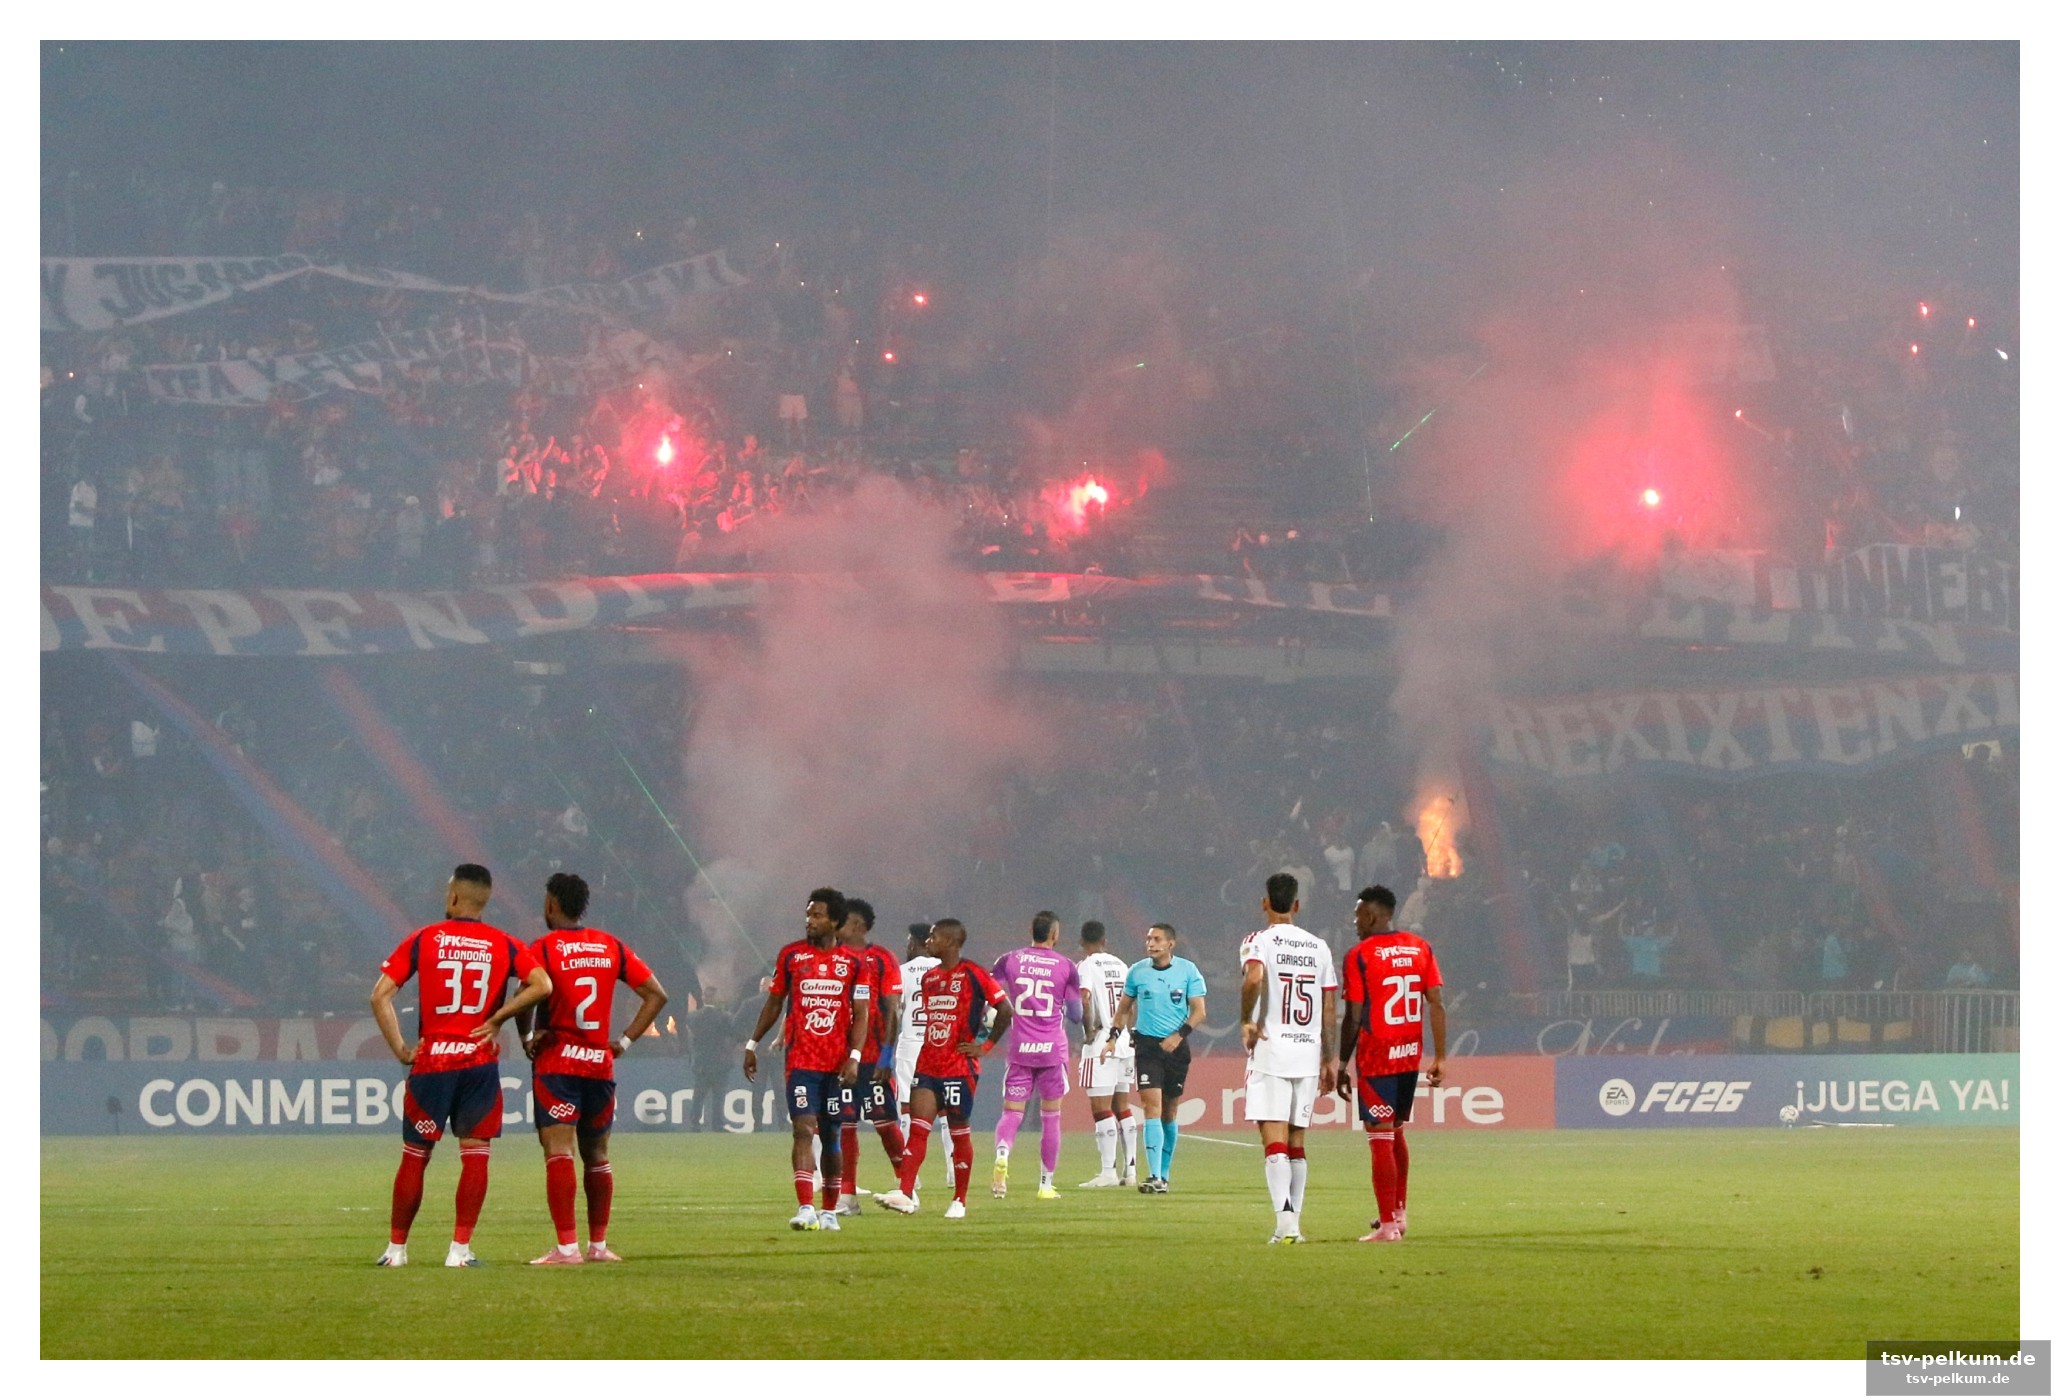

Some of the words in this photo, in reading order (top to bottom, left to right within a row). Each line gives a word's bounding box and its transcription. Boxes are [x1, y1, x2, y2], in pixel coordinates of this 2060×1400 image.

[1284, 938, 1318, 949] Hapvida
[438, 949, 447, 959] D.
[448, 949, 492, 962] LONDOÑO
[436, 960, 492, 1014] 33
[801, 981, 842, 993] Colanta
[574, 976, 600, 1030] 2
[1015, 977, 1055, 1017] 25
[1278, 972, 1316, 1026] 15
[1382, 974, 1421, 1025] 26
[804, 1010, 837, 1030] Pool
[430, 1042, 478, 1055] MAPE
[561, 1044, 606, 1063] MAPEI
[1019, 1042, 1054, 1053] MAPEI
[1389, 1042, 1418, 1059] MAPEI
[873, 1085, 885, 1105] 8
[1606, 1087, 1629, 1100] EA
[1796, 1080, 1941, 1113] ¡JUEGA
[1949, 1079, 2010, 1111] YA!
